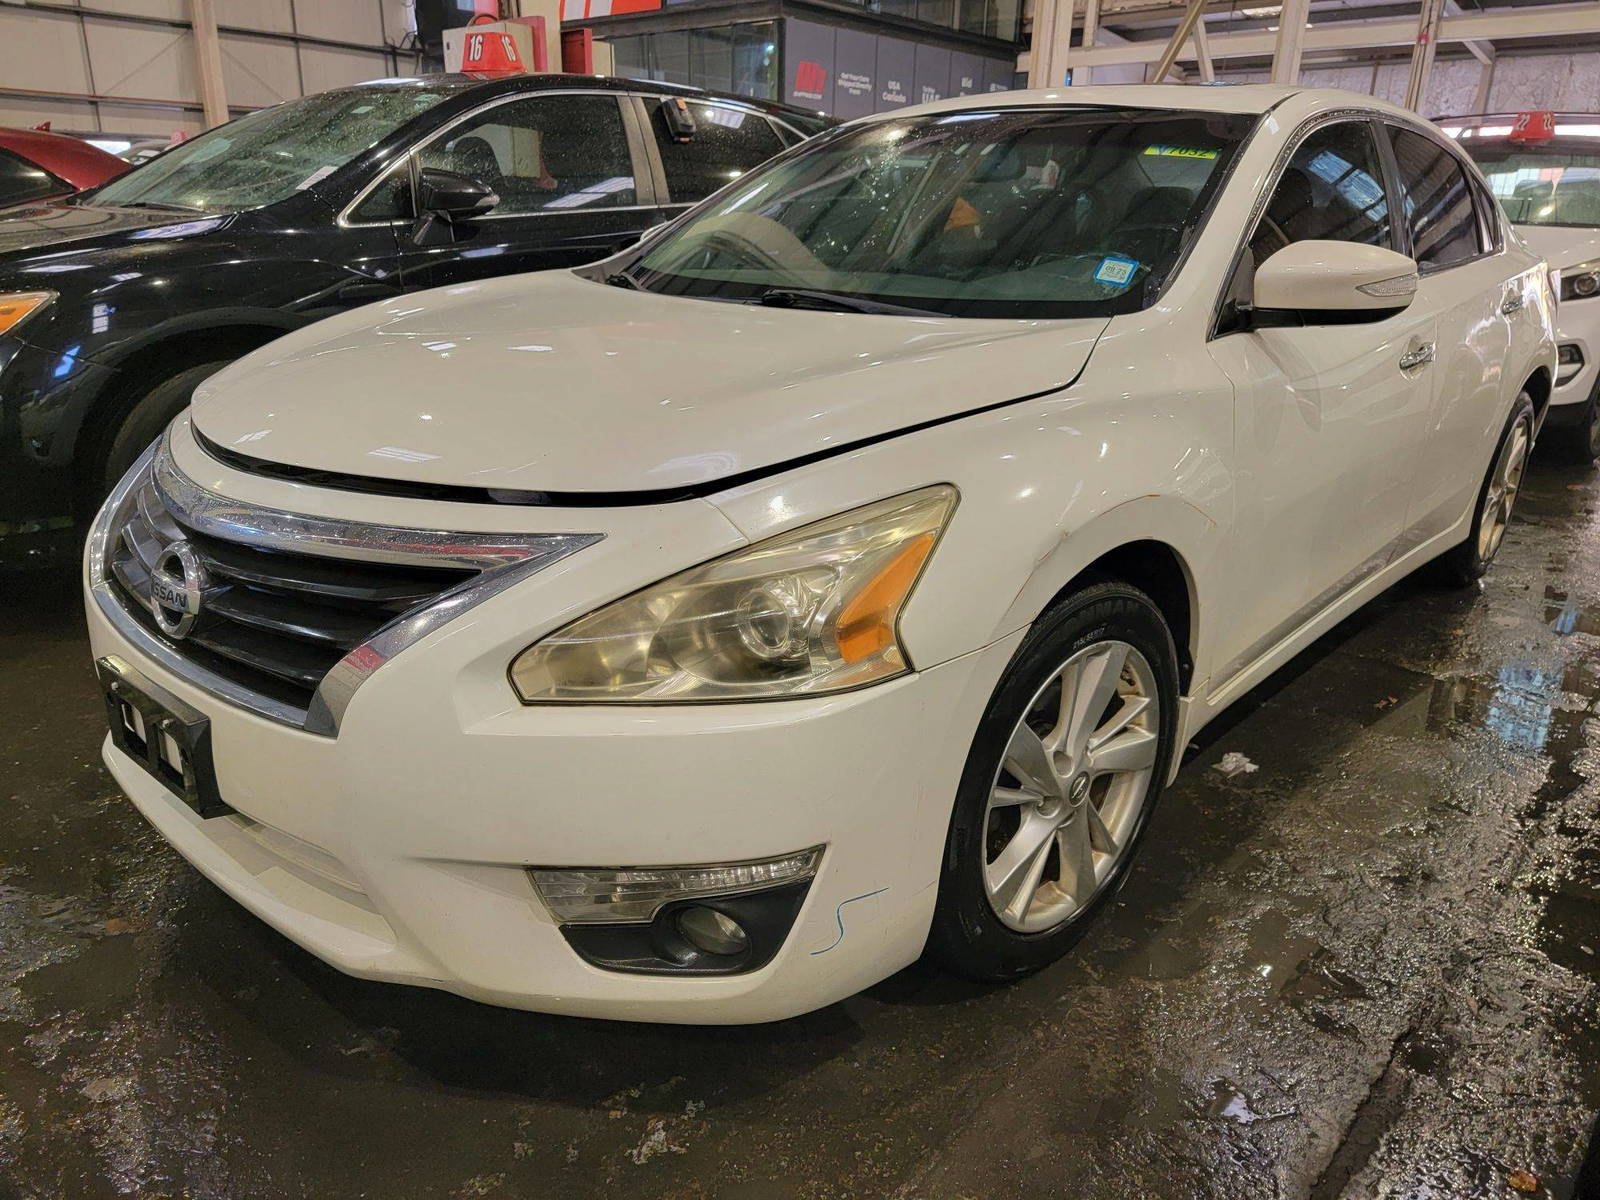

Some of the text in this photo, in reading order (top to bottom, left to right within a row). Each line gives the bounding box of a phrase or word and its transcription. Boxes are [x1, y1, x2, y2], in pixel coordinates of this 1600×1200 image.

[469, 34, 483, 61] 16
[501, 35, 516, 62] 16
[887, 80, 901, 90] USA
[882, 91, 907, 103] Canada
[1517, 114, 1531, 131] 22
[1542, 113, 1553, 131] 22
[150, 577, 188, 608] ISSAN
